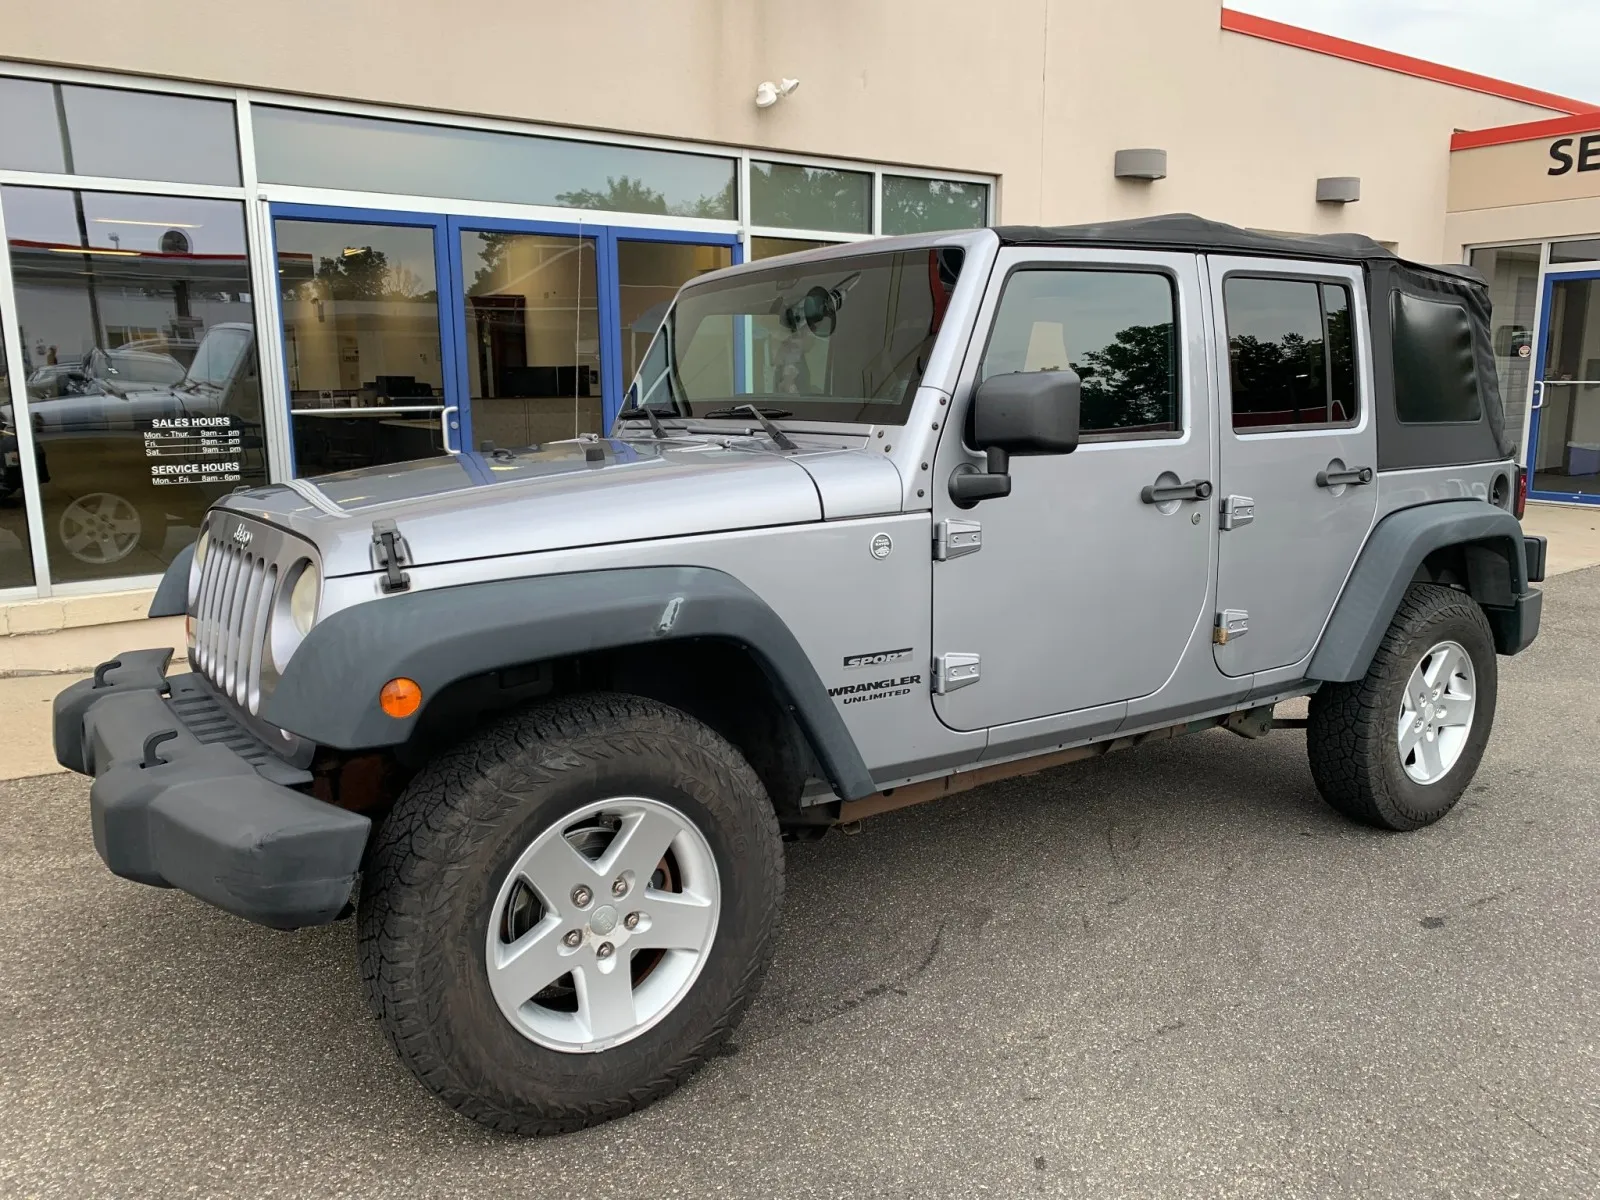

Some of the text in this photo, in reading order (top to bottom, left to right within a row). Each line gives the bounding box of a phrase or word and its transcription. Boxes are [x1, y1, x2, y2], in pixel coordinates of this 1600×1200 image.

[1547, 135, 1600, 176] SE
[152, 417, 231, 428] SALES HOURS
[170, 430, 190, 438] Thur.
[144, 440, 158, 448] Fri.
[145, 448, 161, 457] Sat.
[151, 462, 240, 475] SERVICE HOURS
[152, 477, 172, 485] Mon.
[847, 650, 913, 668] SPORT
[827, 674, 921, 697] WRANGLER
[843, 688, 911, 705] UNLIMITED
